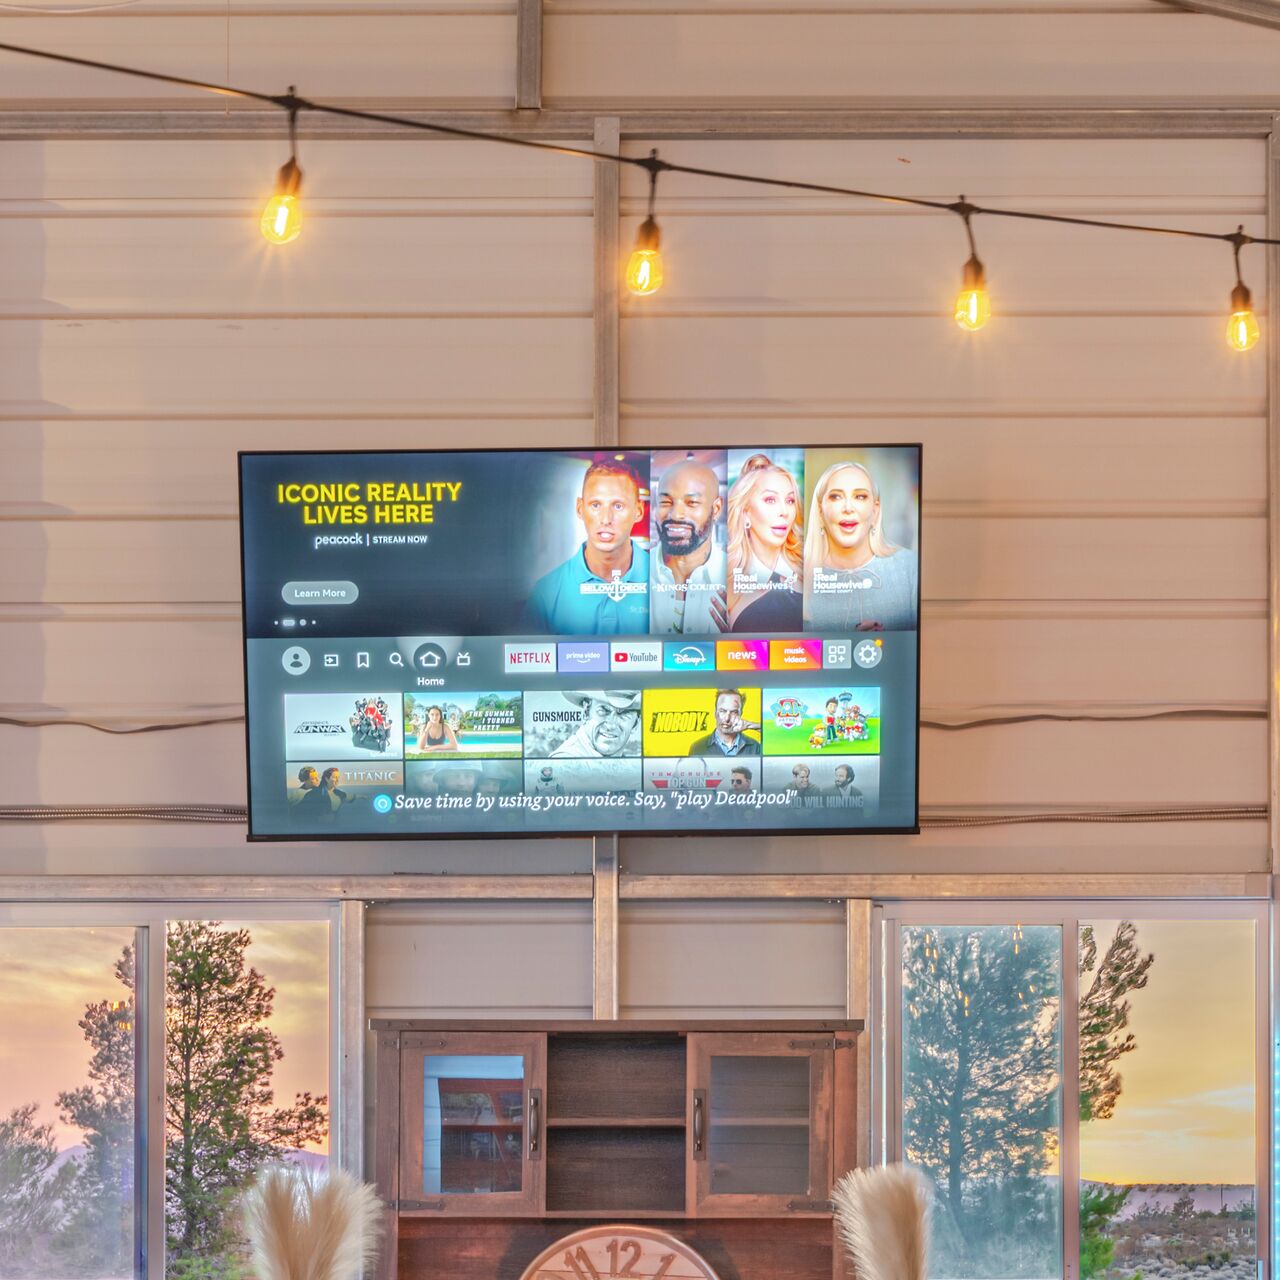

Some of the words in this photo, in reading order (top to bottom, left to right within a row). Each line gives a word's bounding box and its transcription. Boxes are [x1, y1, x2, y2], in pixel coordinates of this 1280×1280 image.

[277, 483, 360, 503] ICONIC
[367, 482, 462, 502] REALITY
[303, 505, 368, 524] LIVES
[374, 504, 434, 524] HERE
[315, 532, 363, 549] peacock
[372, 535, 406, 544] STREAM
[407, 535, 428, 544] NOW
[733, 580, 788, 590] Housewives
[294, 589, 320, 598] Learn
[322, 589, 346, 598] More
[510, 652, 551, 664] NETFLIX
[629, 652, 658, 662] YouTube
[727, 651, 757, 660] news
[417, 677, 445, 686] Home
[532, 711, 582, 722] GUNSMOKE
[653, 711, 707, 733] NOBODY
[344, 771, 397, 782] TITANIC
[394, 794, 432, 809] Save
[436, 793, 472, 808] time
[476, 793, 495, 811] by
[499, 793, 541, 812] using
[542, 795, 584, 811] your
[586, 791, 630, 807] voice.
[634, 791, 666, 810] Say,
[671, 790, 712, 810] "play
[715, 789, 798, 810] Deadpool"
[804, 796, 824, 808] WILL
[826, 795, 864, 808] HUNTING
[606, 1238, 642, 1279] 12
